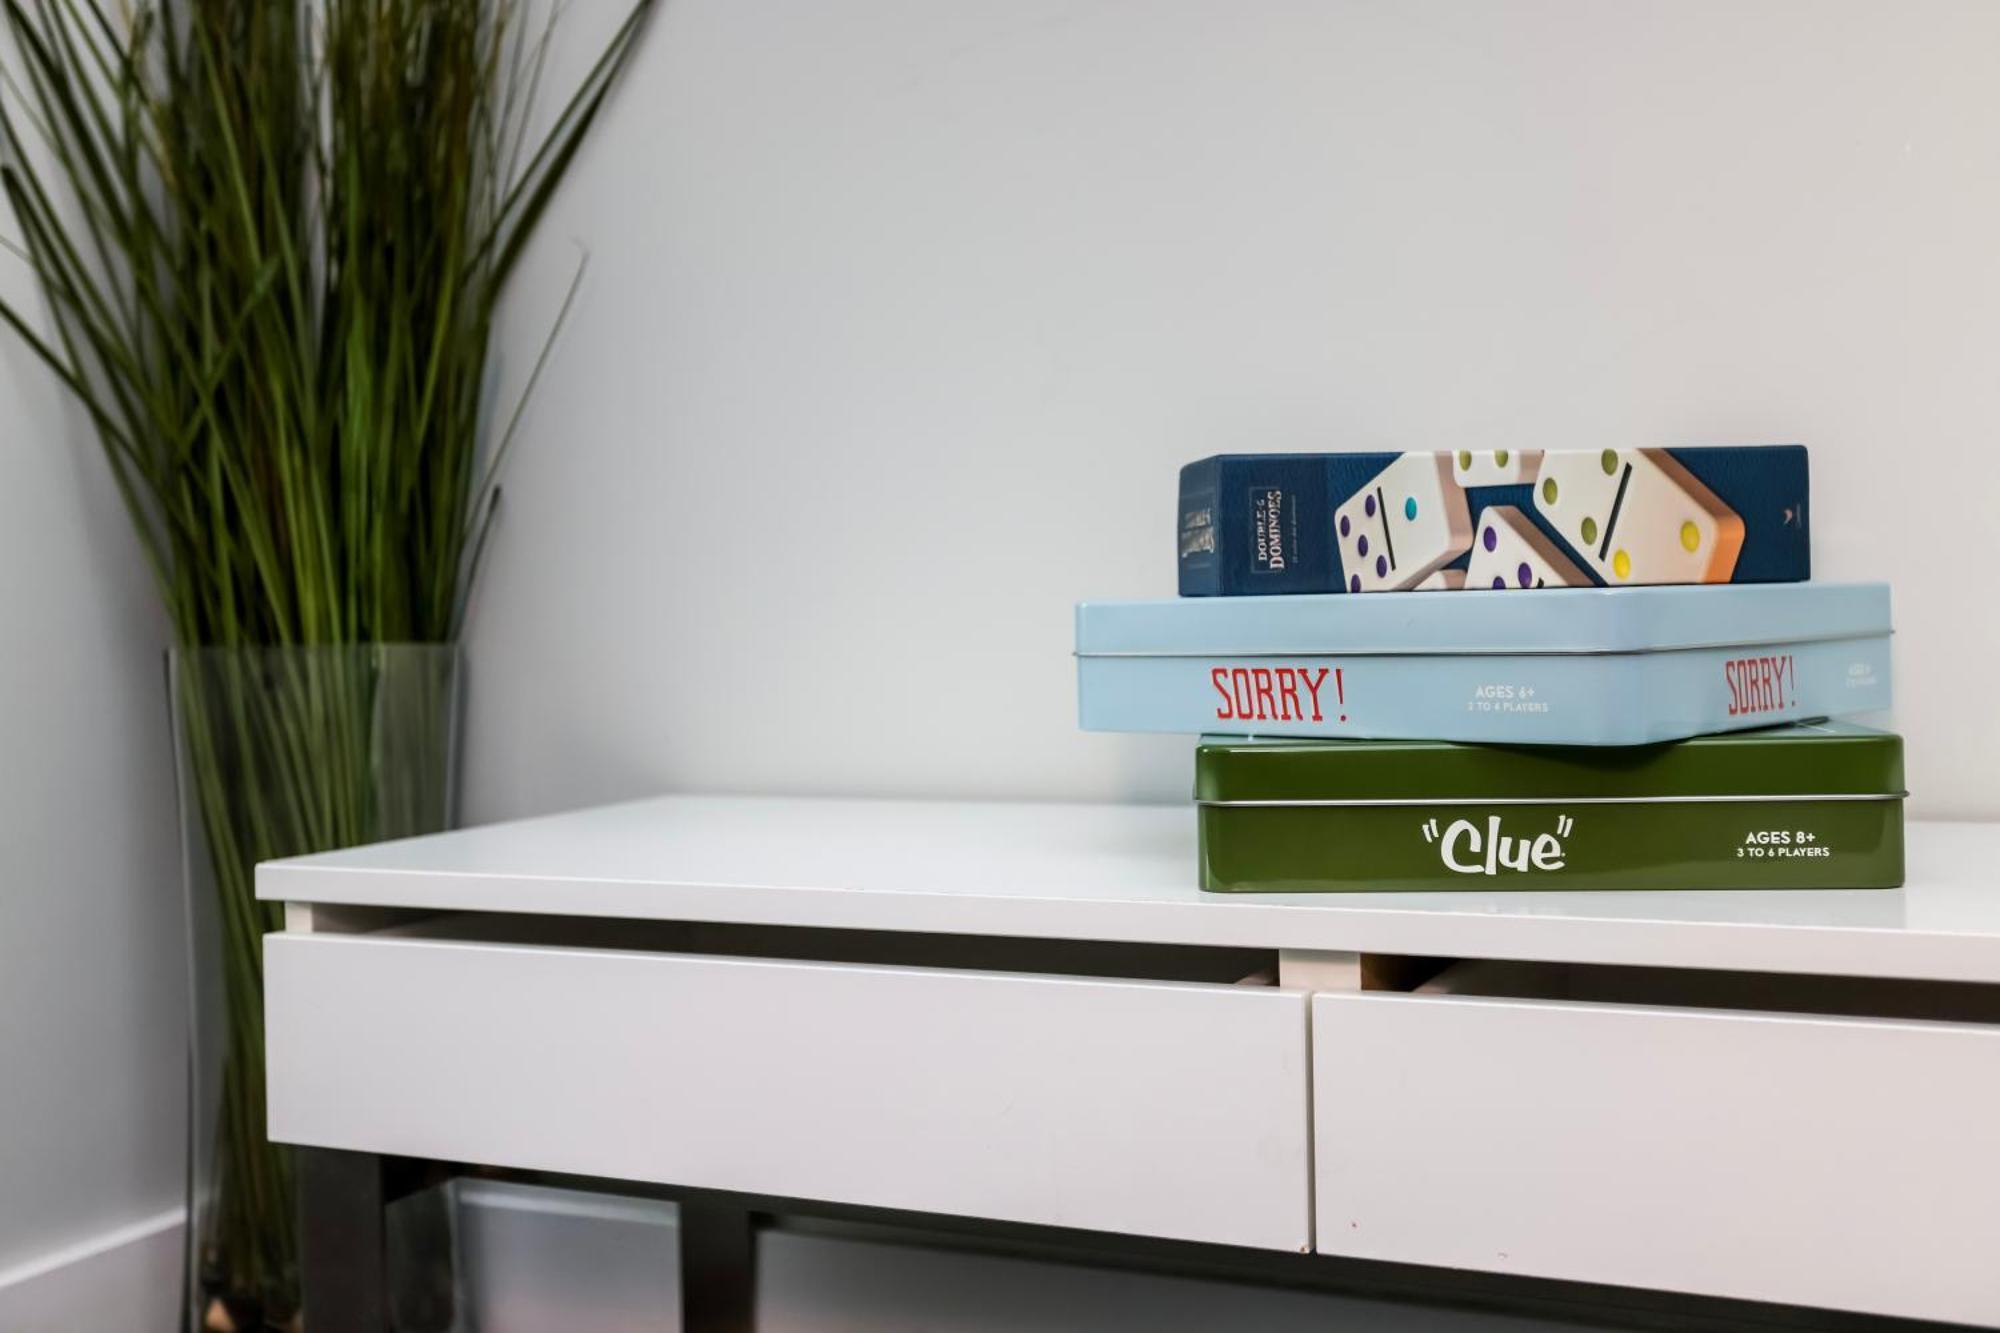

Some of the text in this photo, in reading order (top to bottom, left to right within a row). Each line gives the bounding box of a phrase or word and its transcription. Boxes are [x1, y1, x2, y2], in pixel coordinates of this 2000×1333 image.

[1267, 490, 1285, 569] DOMINOES
[1475, 684, 1514, 699] AGES
[1725, 655, 1796, 715] SORRY!
[1211, 667, 1347, 722] SORRY!
[1503, 701, 1549, 713] PLAYERS
[1745, 831, 1816, 844] AGES 8+
[1737, 847, 1831, 857] 3 TO 6 PLAYERS
